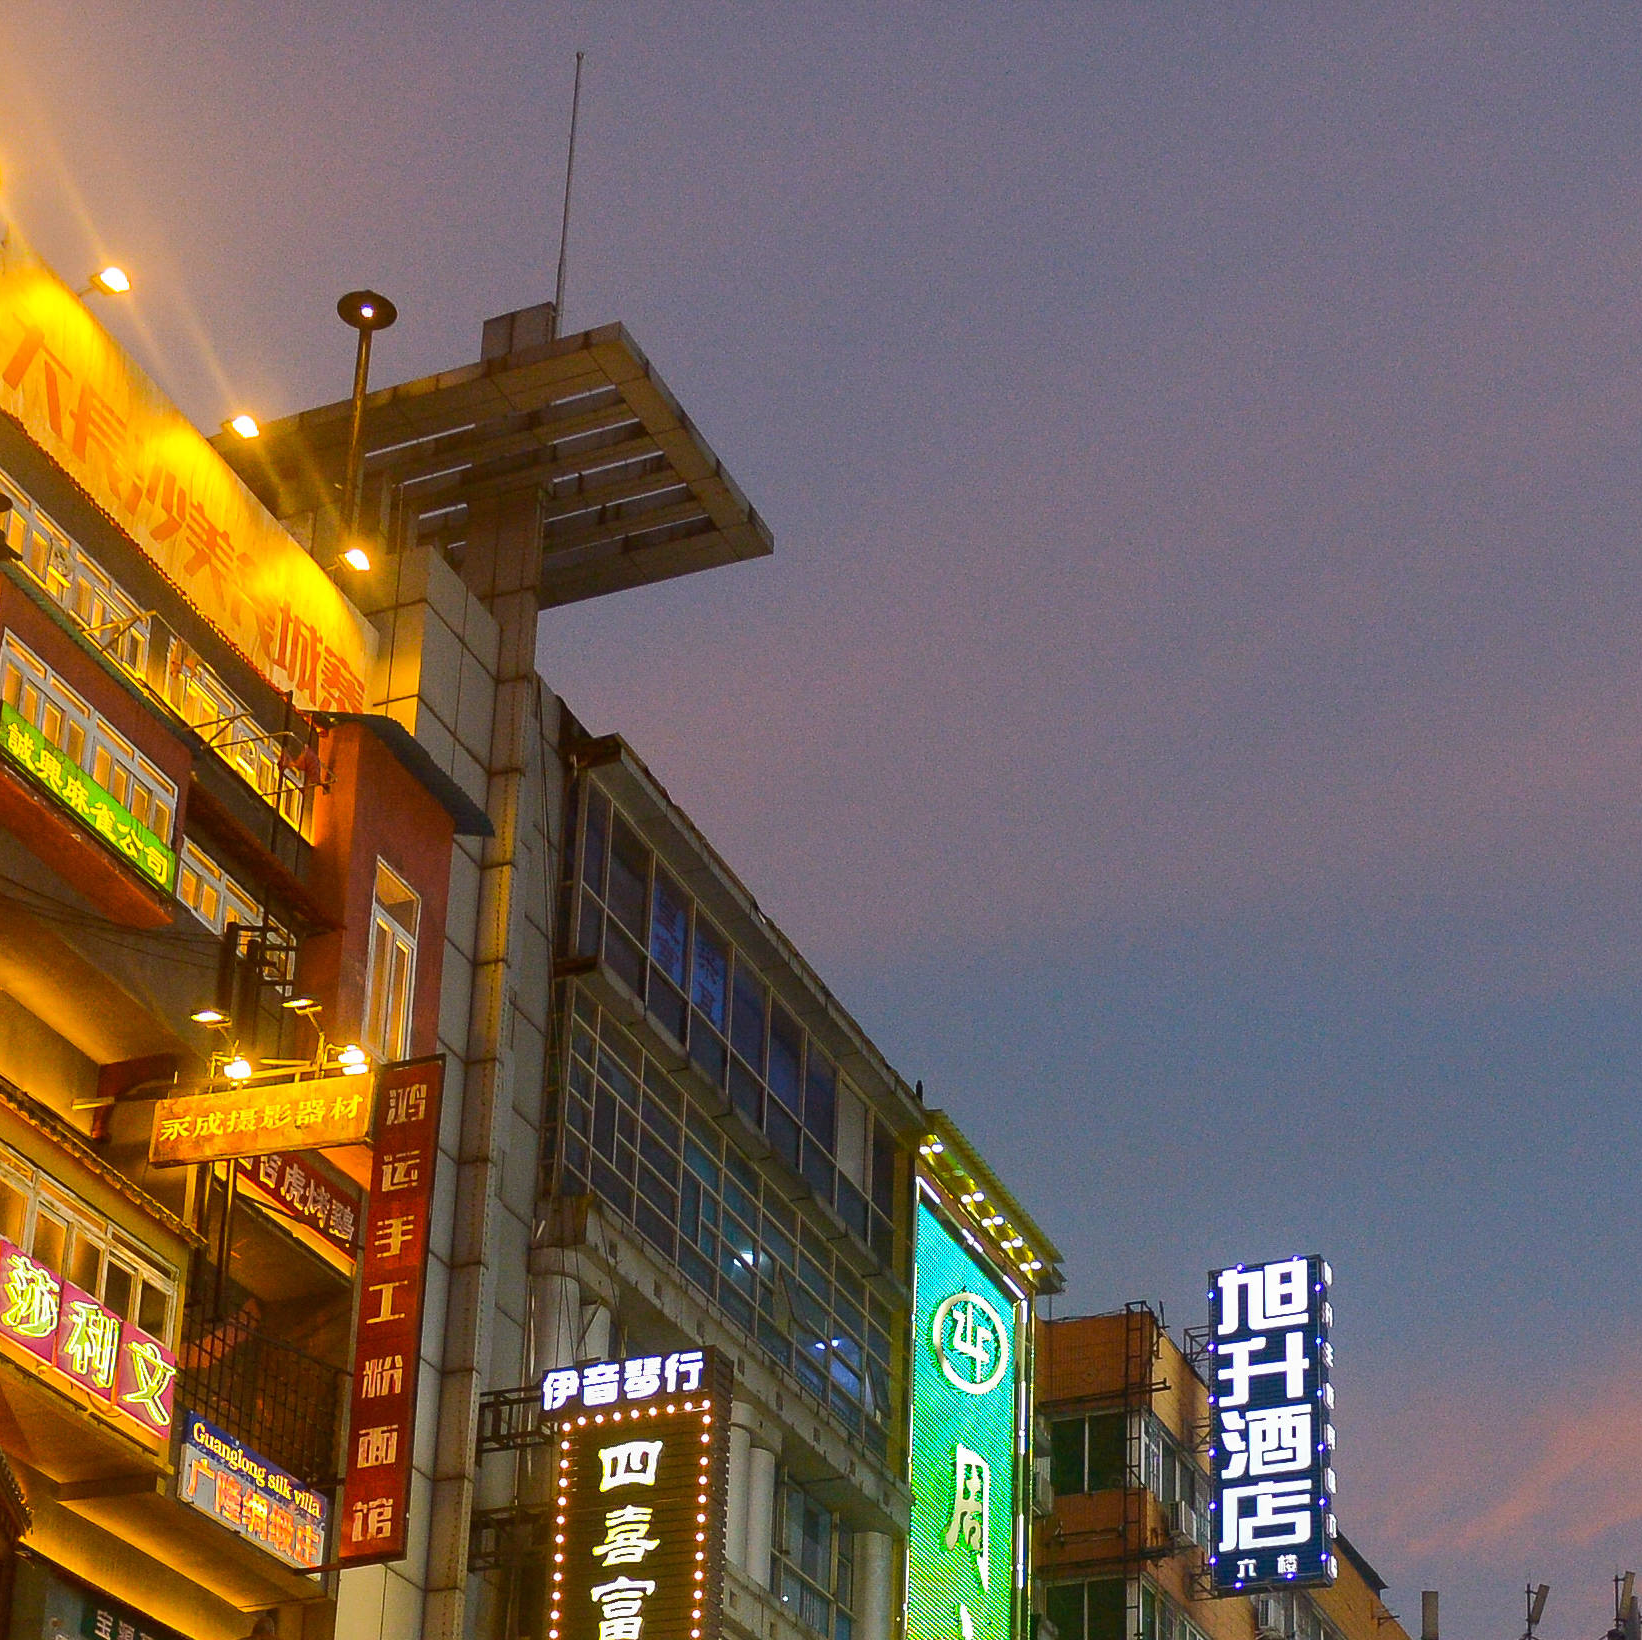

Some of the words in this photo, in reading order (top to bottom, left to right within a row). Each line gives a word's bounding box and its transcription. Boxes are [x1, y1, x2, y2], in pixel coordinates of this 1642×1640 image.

[542, 1352, 705, 1411] 伊音琴行
[1216, 1258, 1314, 1552] 旭升酒店
[192, 1421, 267, 1487] Guanglong
[266, 1465, 294, 1500] silk
[290, 1481, 322, 1518] villa
